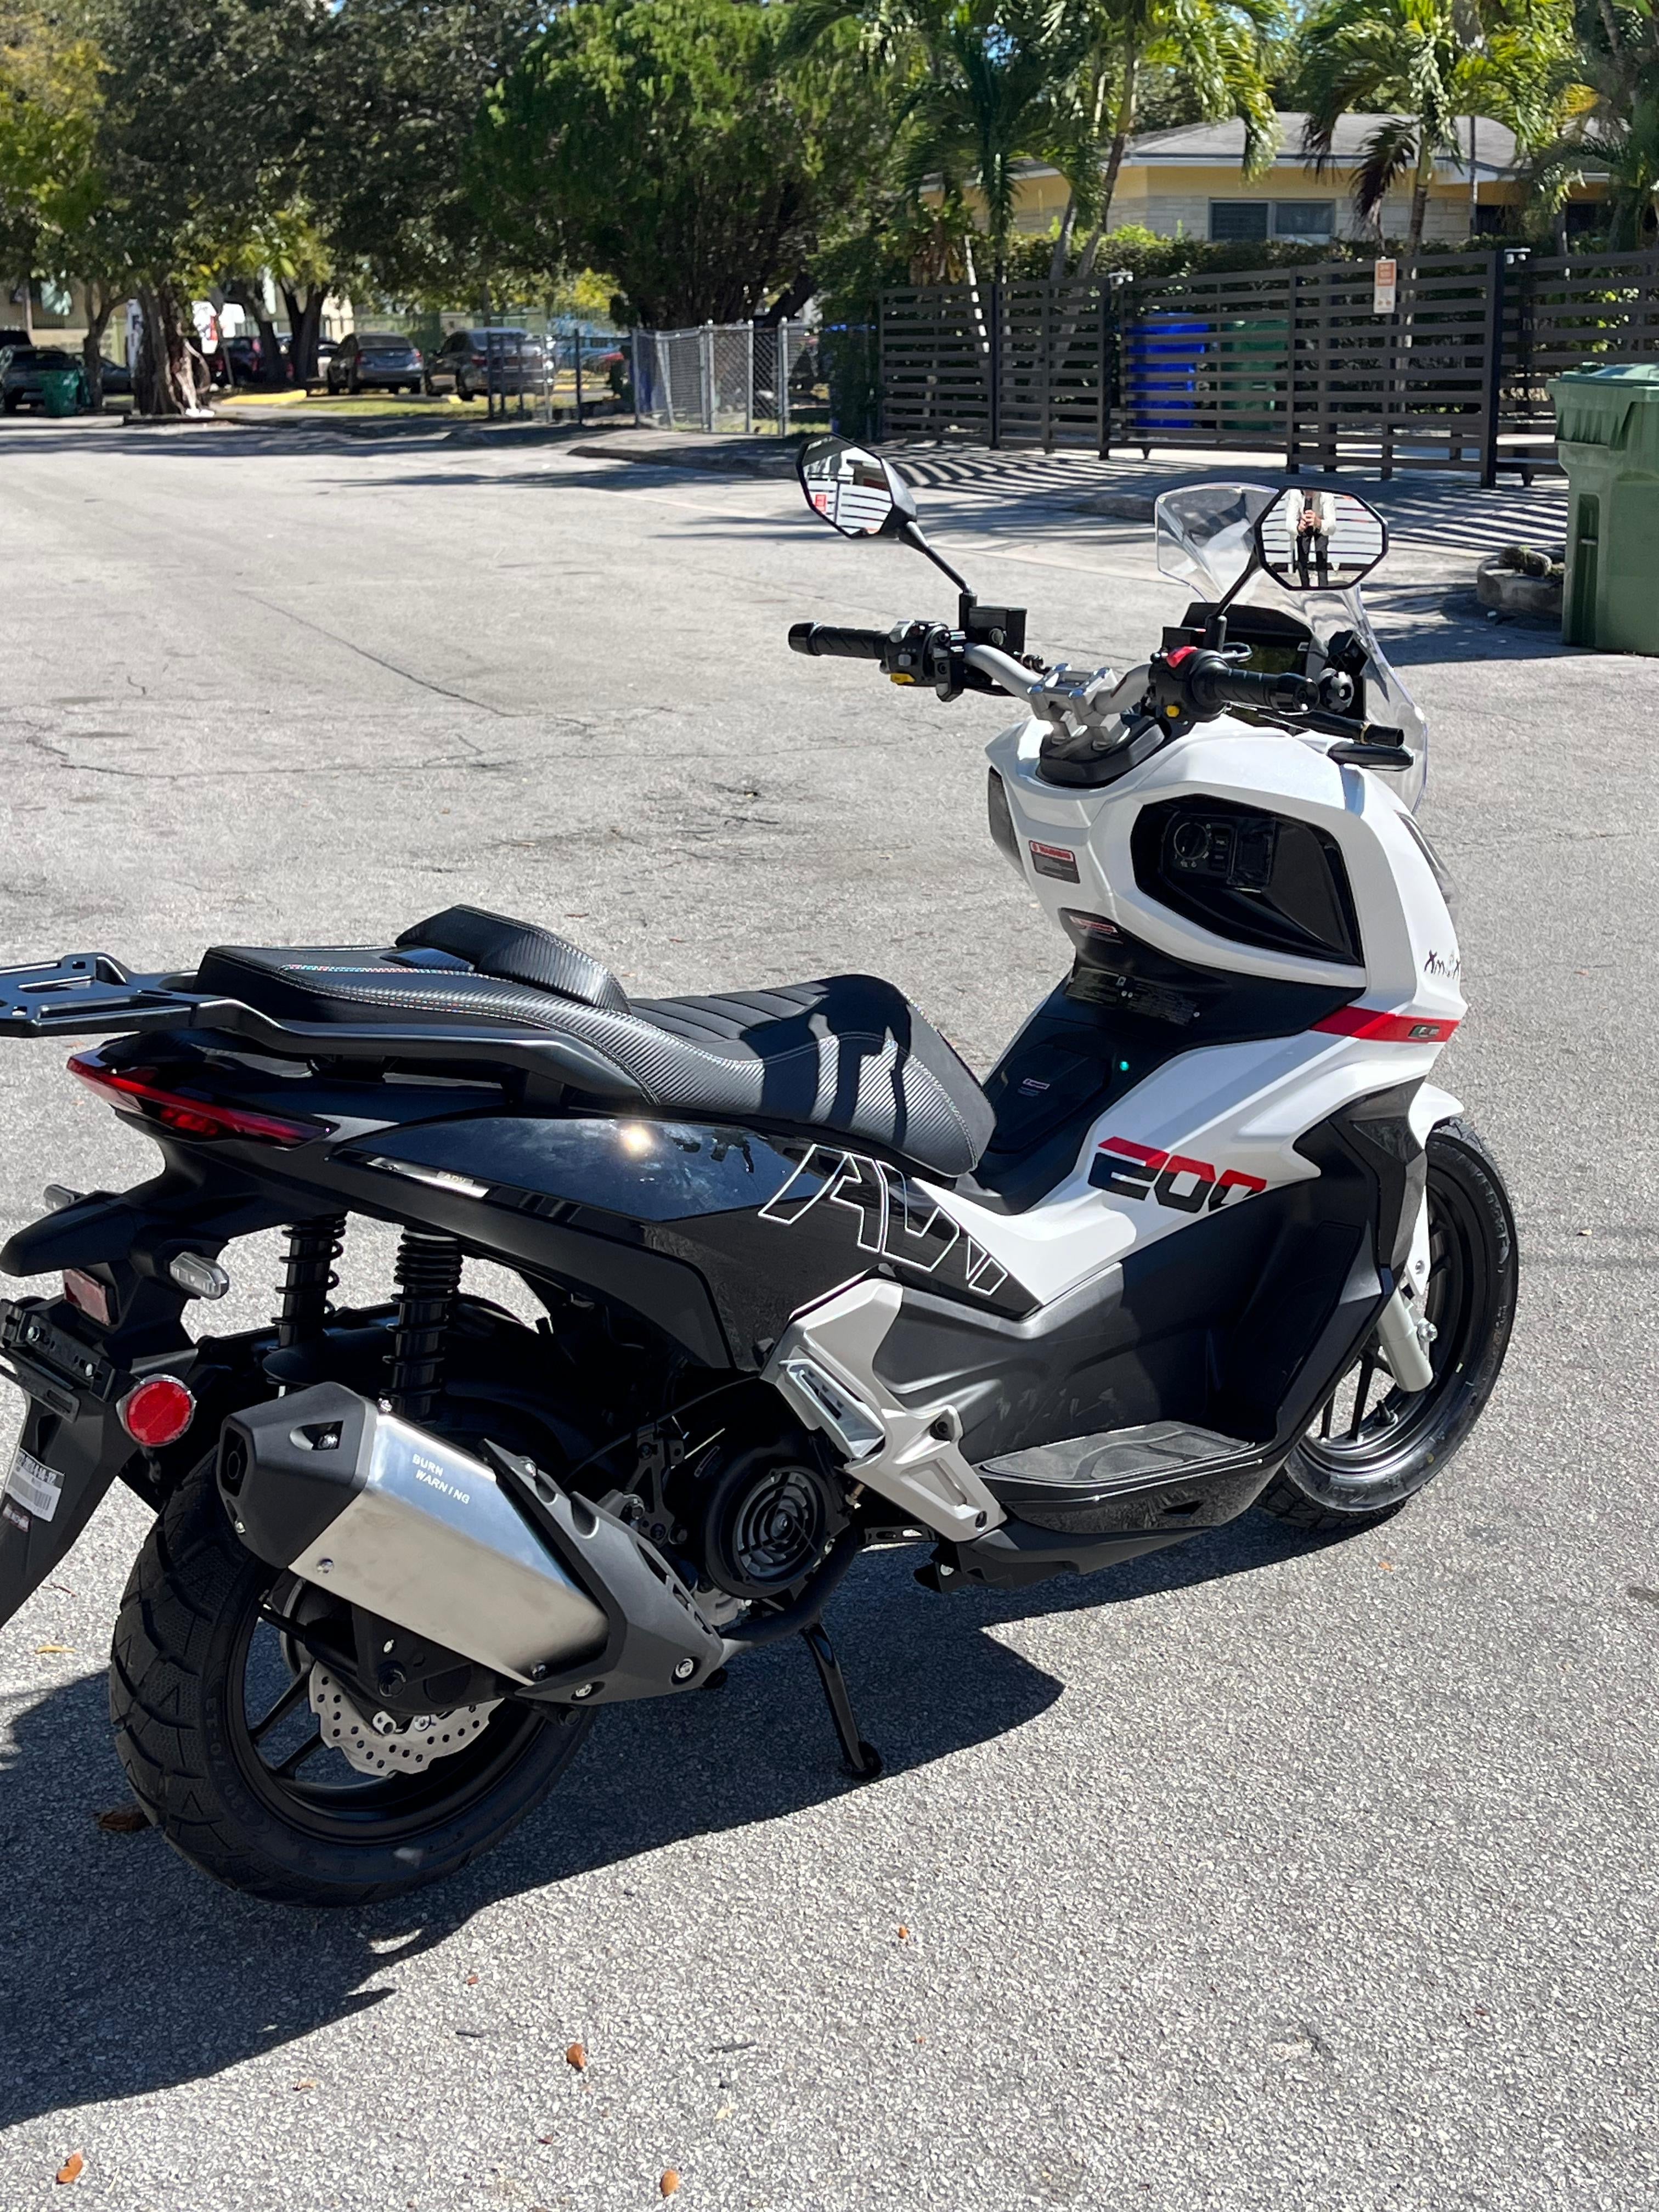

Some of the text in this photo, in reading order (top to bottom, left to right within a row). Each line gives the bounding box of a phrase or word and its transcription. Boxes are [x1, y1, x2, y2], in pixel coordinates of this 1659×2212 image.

[443, 1173, 466, 1183] ADV
[1088, 1136, 1267, 1214] 200
[413, 1453, 443, 1476] BURN
[416, 1469, 470, 1504] WARNING
